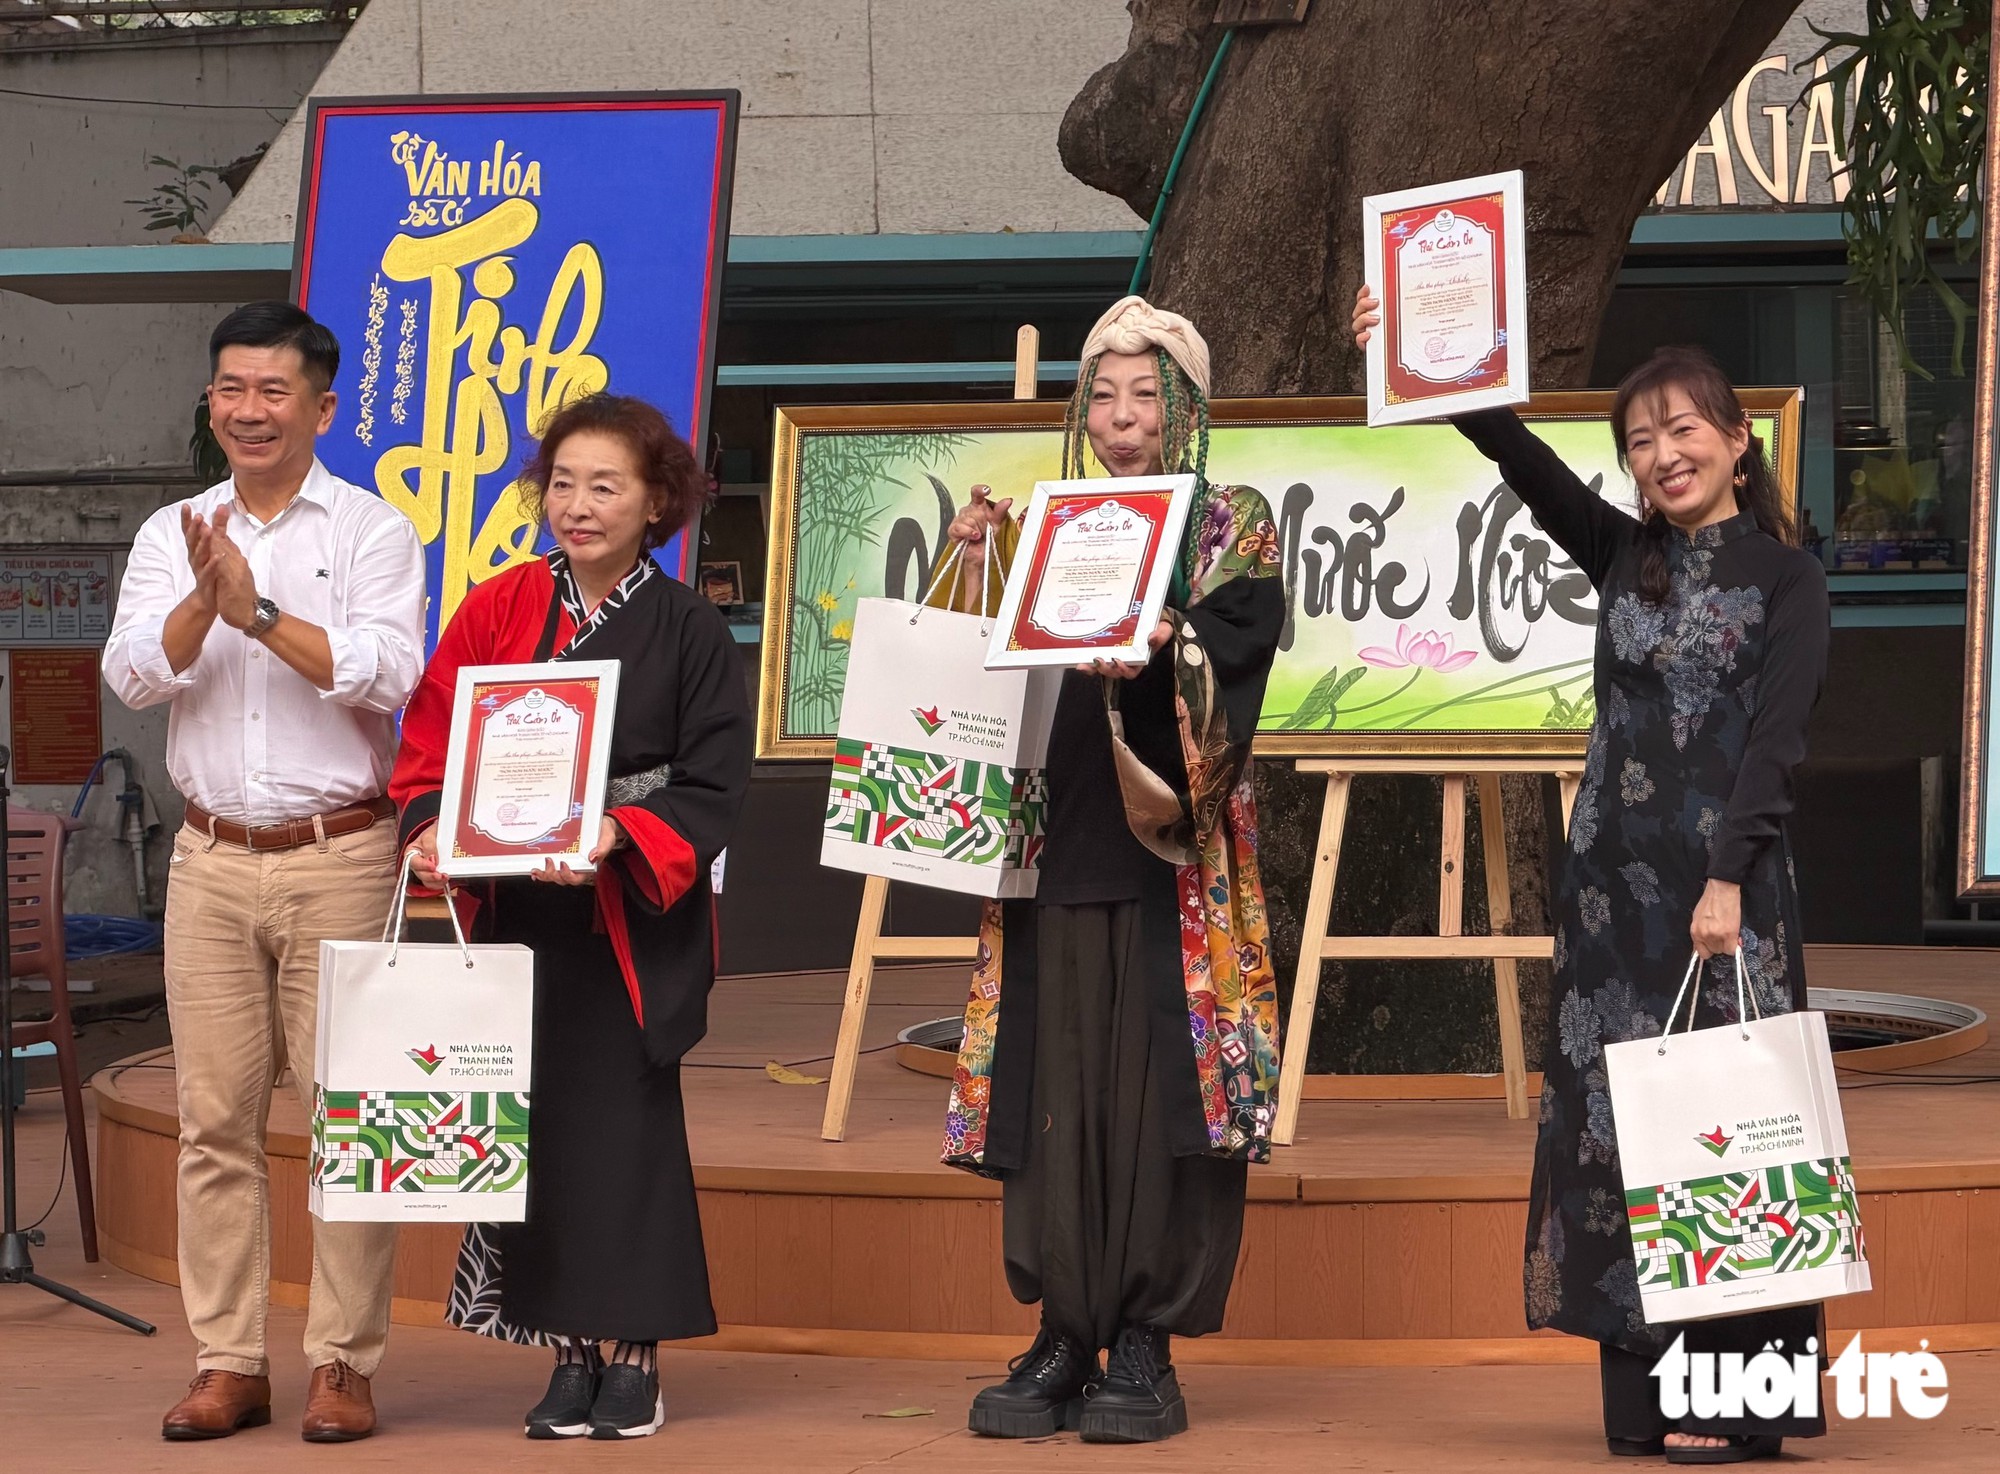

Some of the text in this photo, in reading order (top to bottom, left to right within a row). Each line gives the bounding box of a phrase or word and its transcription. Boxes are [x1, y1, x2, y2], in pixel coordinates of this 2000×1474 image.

[404, 140, 541, 196] VĂN HÓA
[951, 710, 1007, 727] NHÀ VĂN HÓA
[958, 722, 1006, 738] THANH NIÊN
[450, 1044, 513, 1053] NHÀ VĂN HÓA
[492, 1055, 513, 1065] NIÊN
[491, 1068, 513, 1076] MINH
[1736, 1113, 1801, 1131] NHÀ VĂN HÓA
[1747, 1125, 1802, 1141] THANH NIÊN
[1782, 1137, 1804, 1148] MINH
